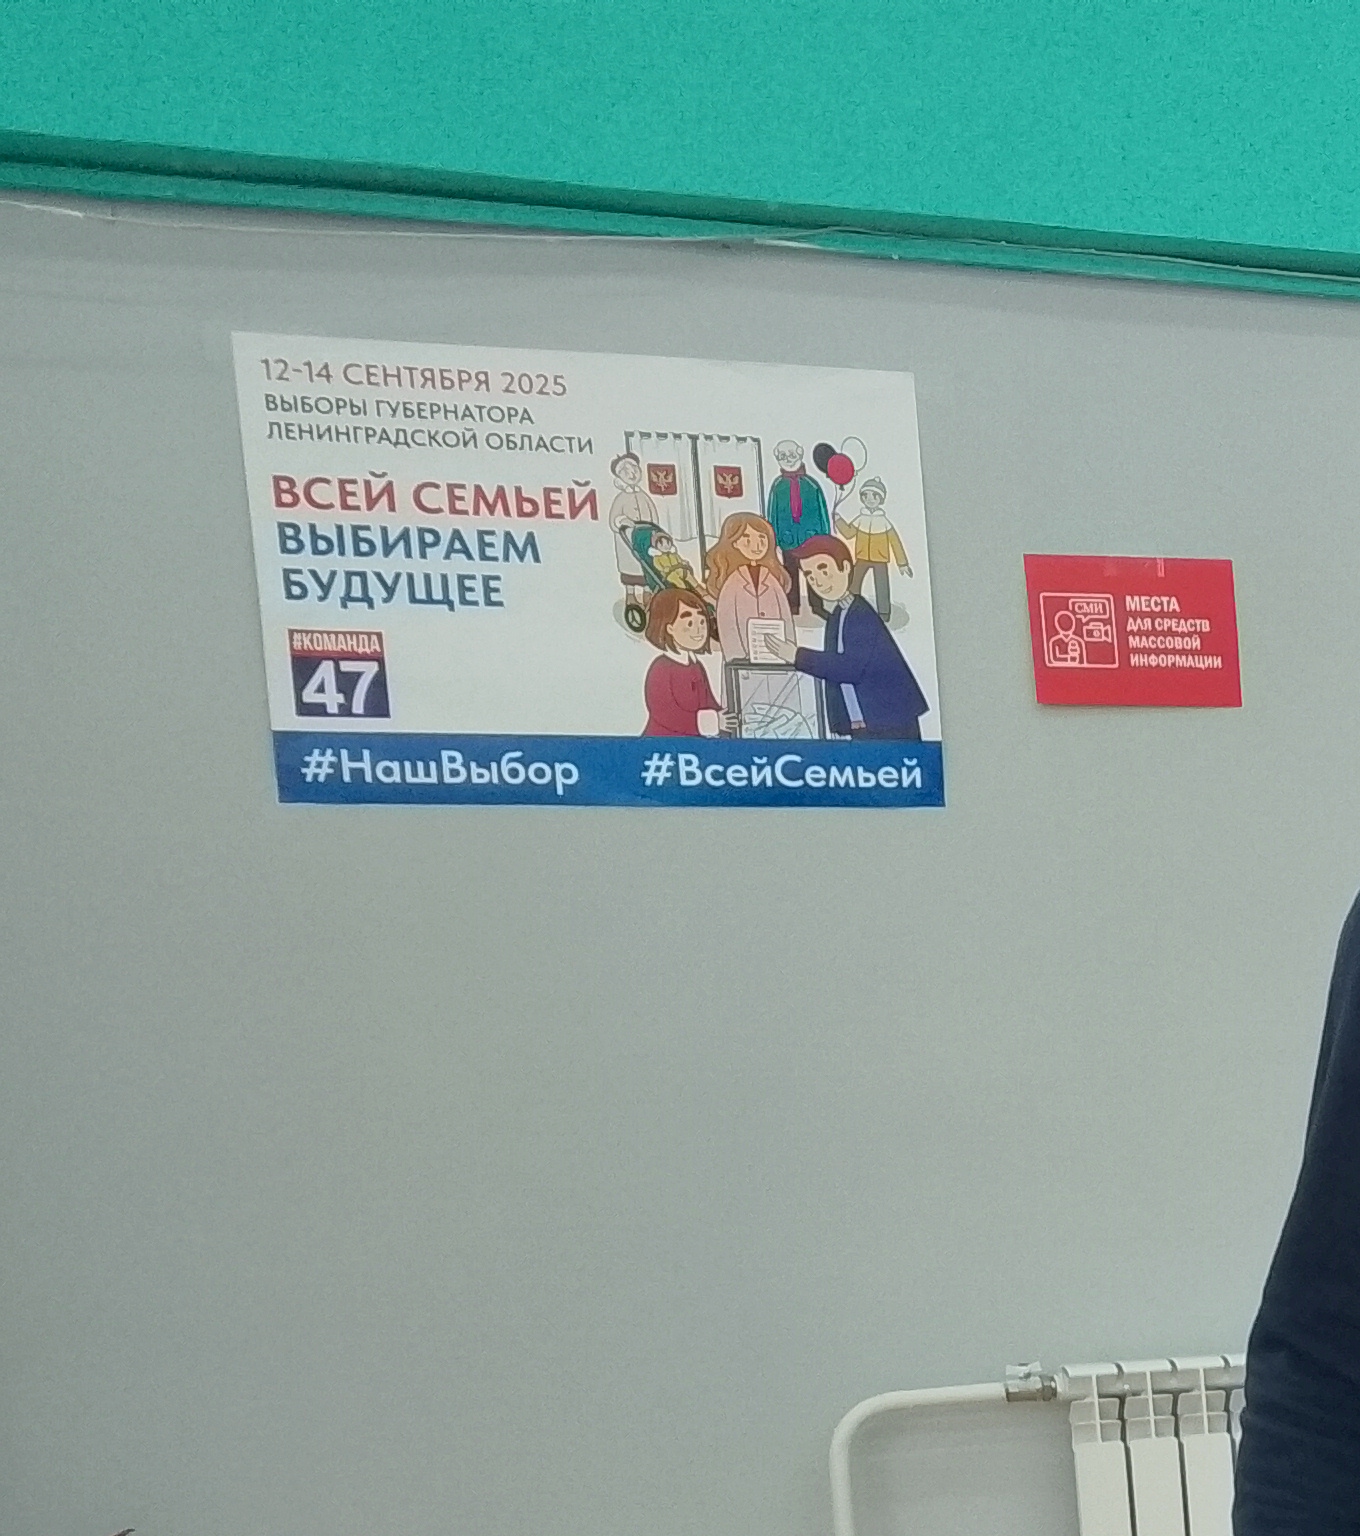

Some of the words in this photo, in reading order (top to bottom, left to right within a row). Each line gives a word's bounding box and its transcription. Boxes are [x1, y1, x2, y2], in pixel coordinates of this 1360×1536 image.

[260, 357, 334, 384] 12-14
[342, 362, 491, 393] СЕНТЯБРЯ
[500, 371, 568, 397] 2025
[264, 393, 368, 417] ВЫБОРЫ
[375, 399, 535, 425] ГУБЕРНАТОРА
[267, 421, 478, 449] ЛЕНИНГРАДСКОЙ
[485, 433, 594, 454] ОБЛАСТИ
[271, 470, 397, 513] ВСЕЙ
[412, 479, 599, 521] СЕМЬЕЙ
[277, 521, 542, 564] ВЫБИРАЕМ
[282, 567, 505, 612] БУДУЩЕЕ
[1125, 595, 1181, 612] МЕСТА
[1075, 602, 1103, 614] СМИ
[1126, 616, 1153, 632] ДЛЯ
[1154, 618, 1211, 633] СРЕДСТВ
[292, 631, 382, 654] #КОМАНДА
[1128, 634, 1201, 650] МАССОВОЙ
[1130, 653, 1222, 670] ИНФОРМАЦИИ
[302, 659, 379, 714] 47
[300, 748, 580, 796] #НашВыбор
[640, 752, 922, 789] #ВсейСемьей
